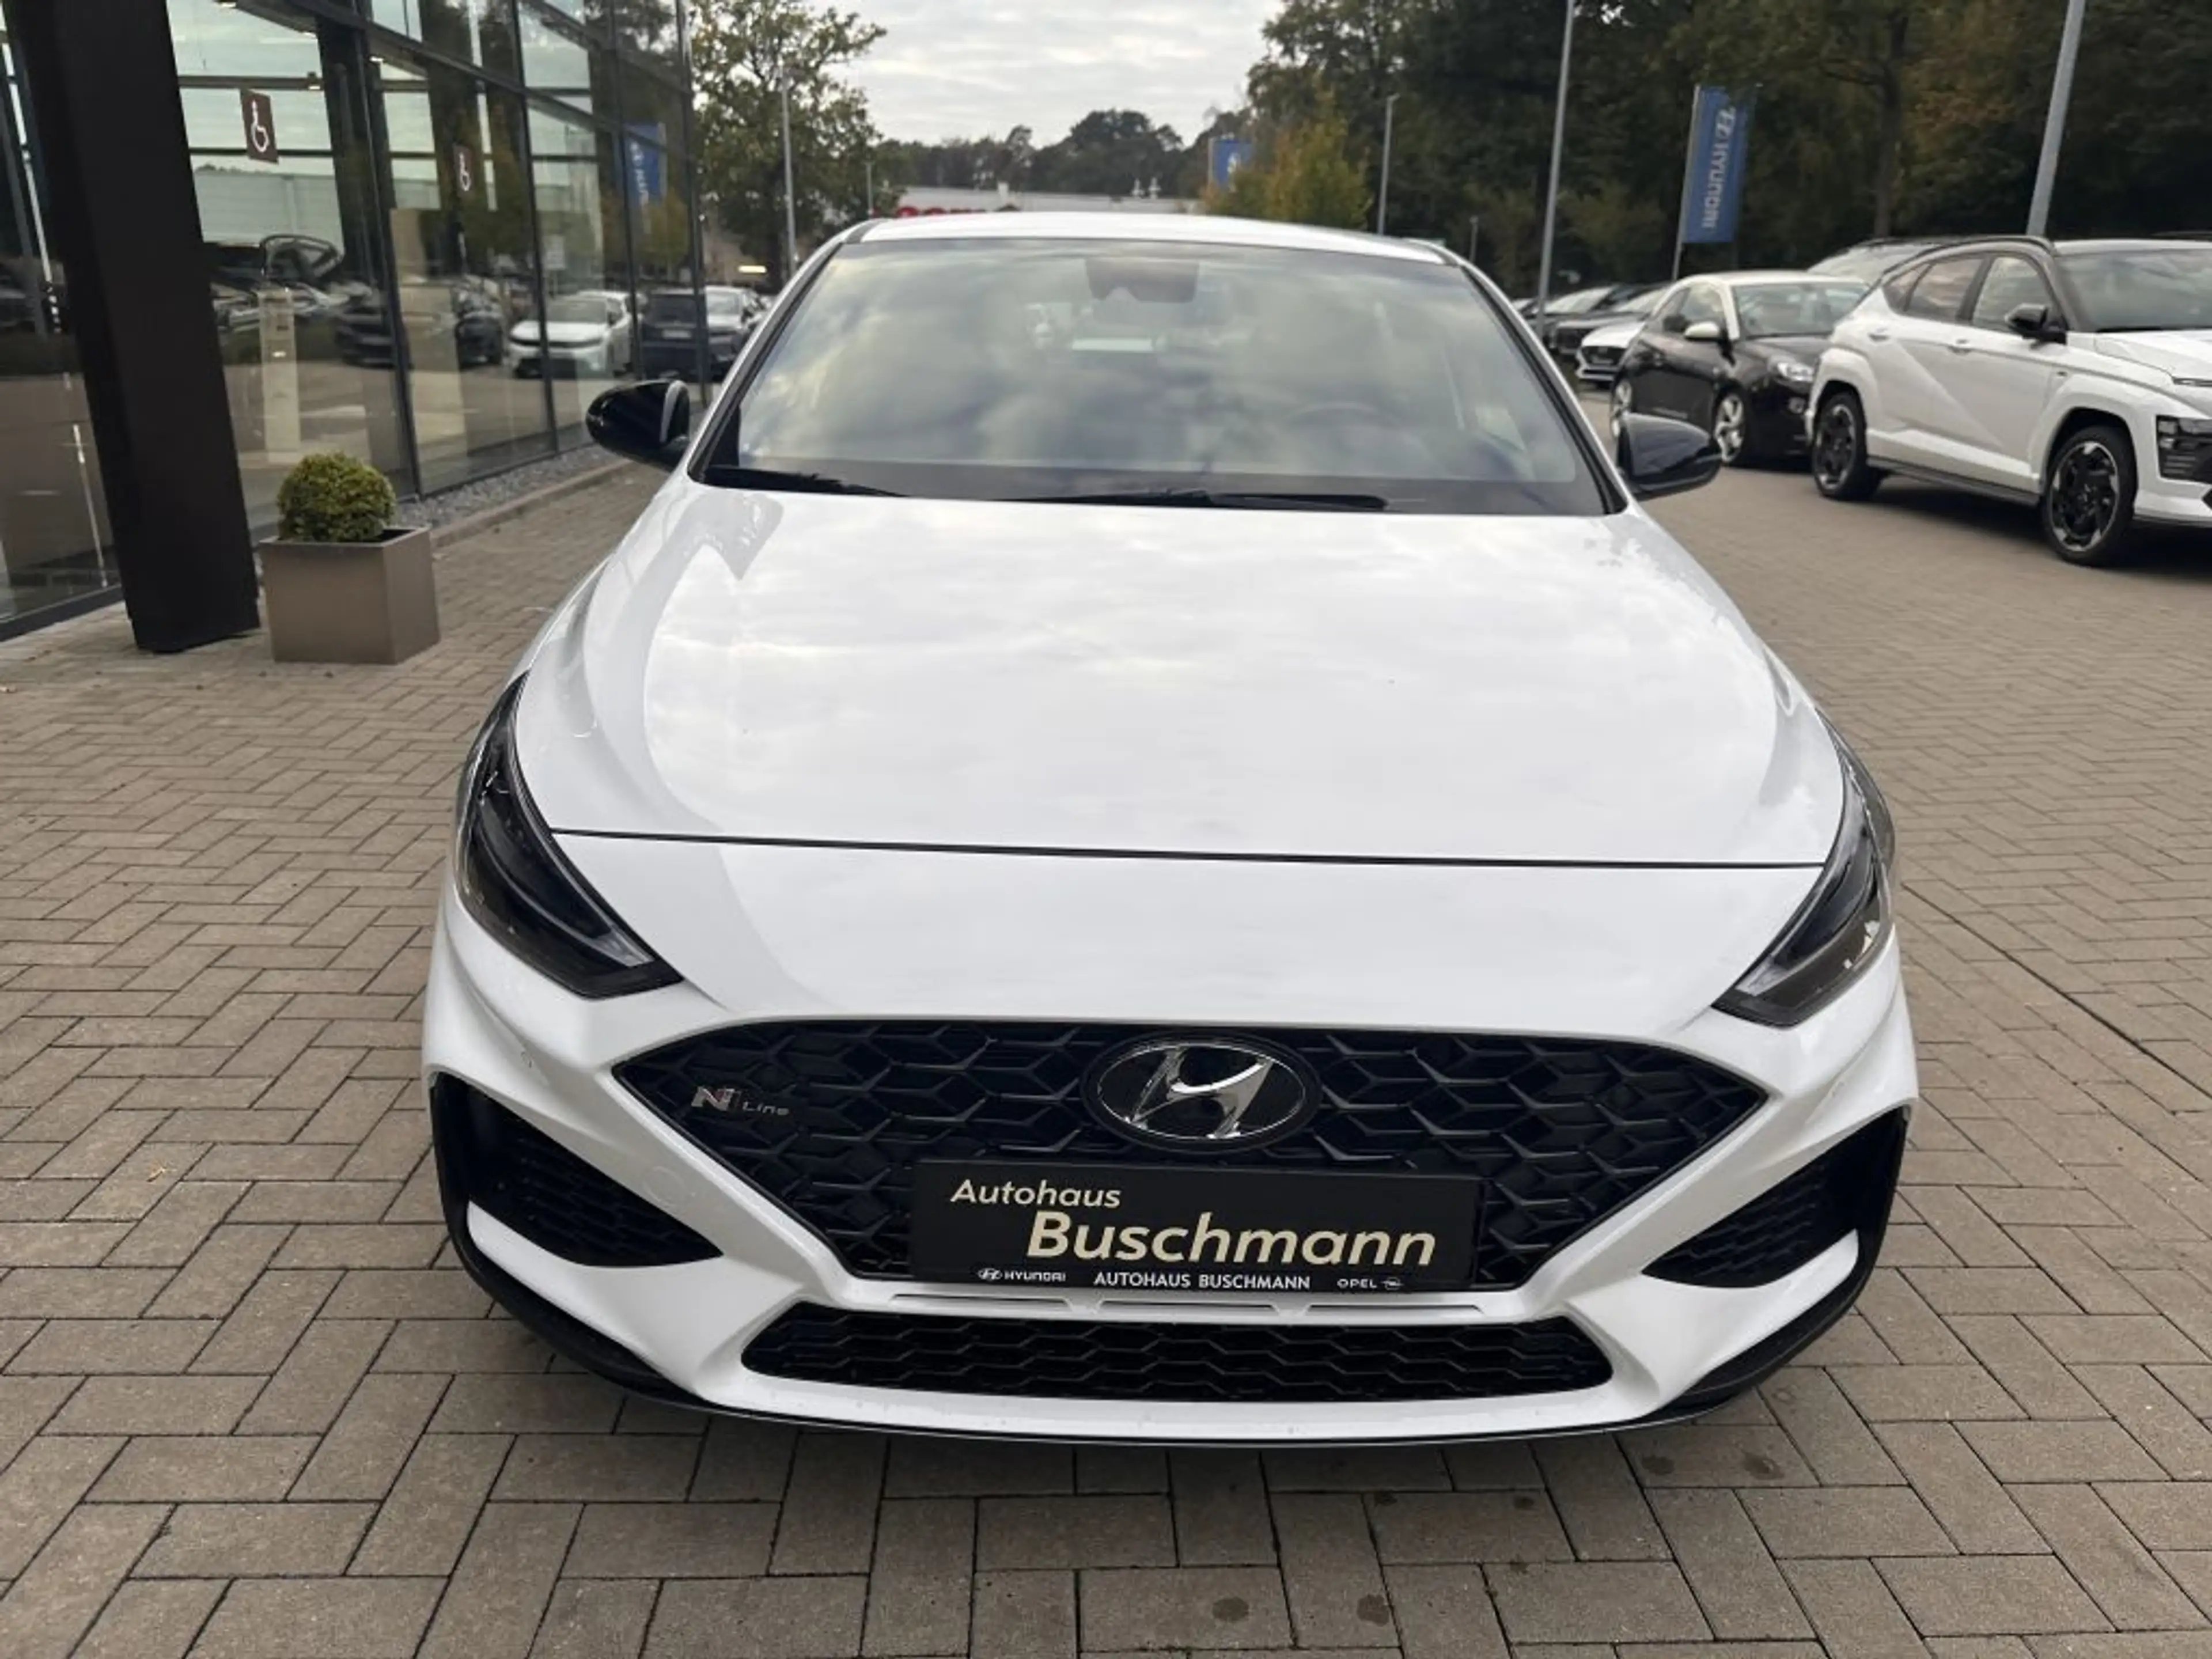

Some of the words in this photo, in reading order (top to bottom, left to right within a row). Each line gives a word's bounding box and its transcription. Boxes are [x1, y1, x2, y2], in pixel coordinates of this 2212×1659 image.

[1702, 143, 1728, 228] HYUNDAI
[950, 1179, 1121, 1208] Autohaus
[1027, 1210, 1435, 1266] Buschmann
[1004, 1271, 1066, 1282] HYUNDAI
[1093, 1271, 1191, 1288] AUTOHAUS
[1199, 1274, 1310, 1289] BUSCHMANN
[1337, 1278, 1378, 1289] OPEL
